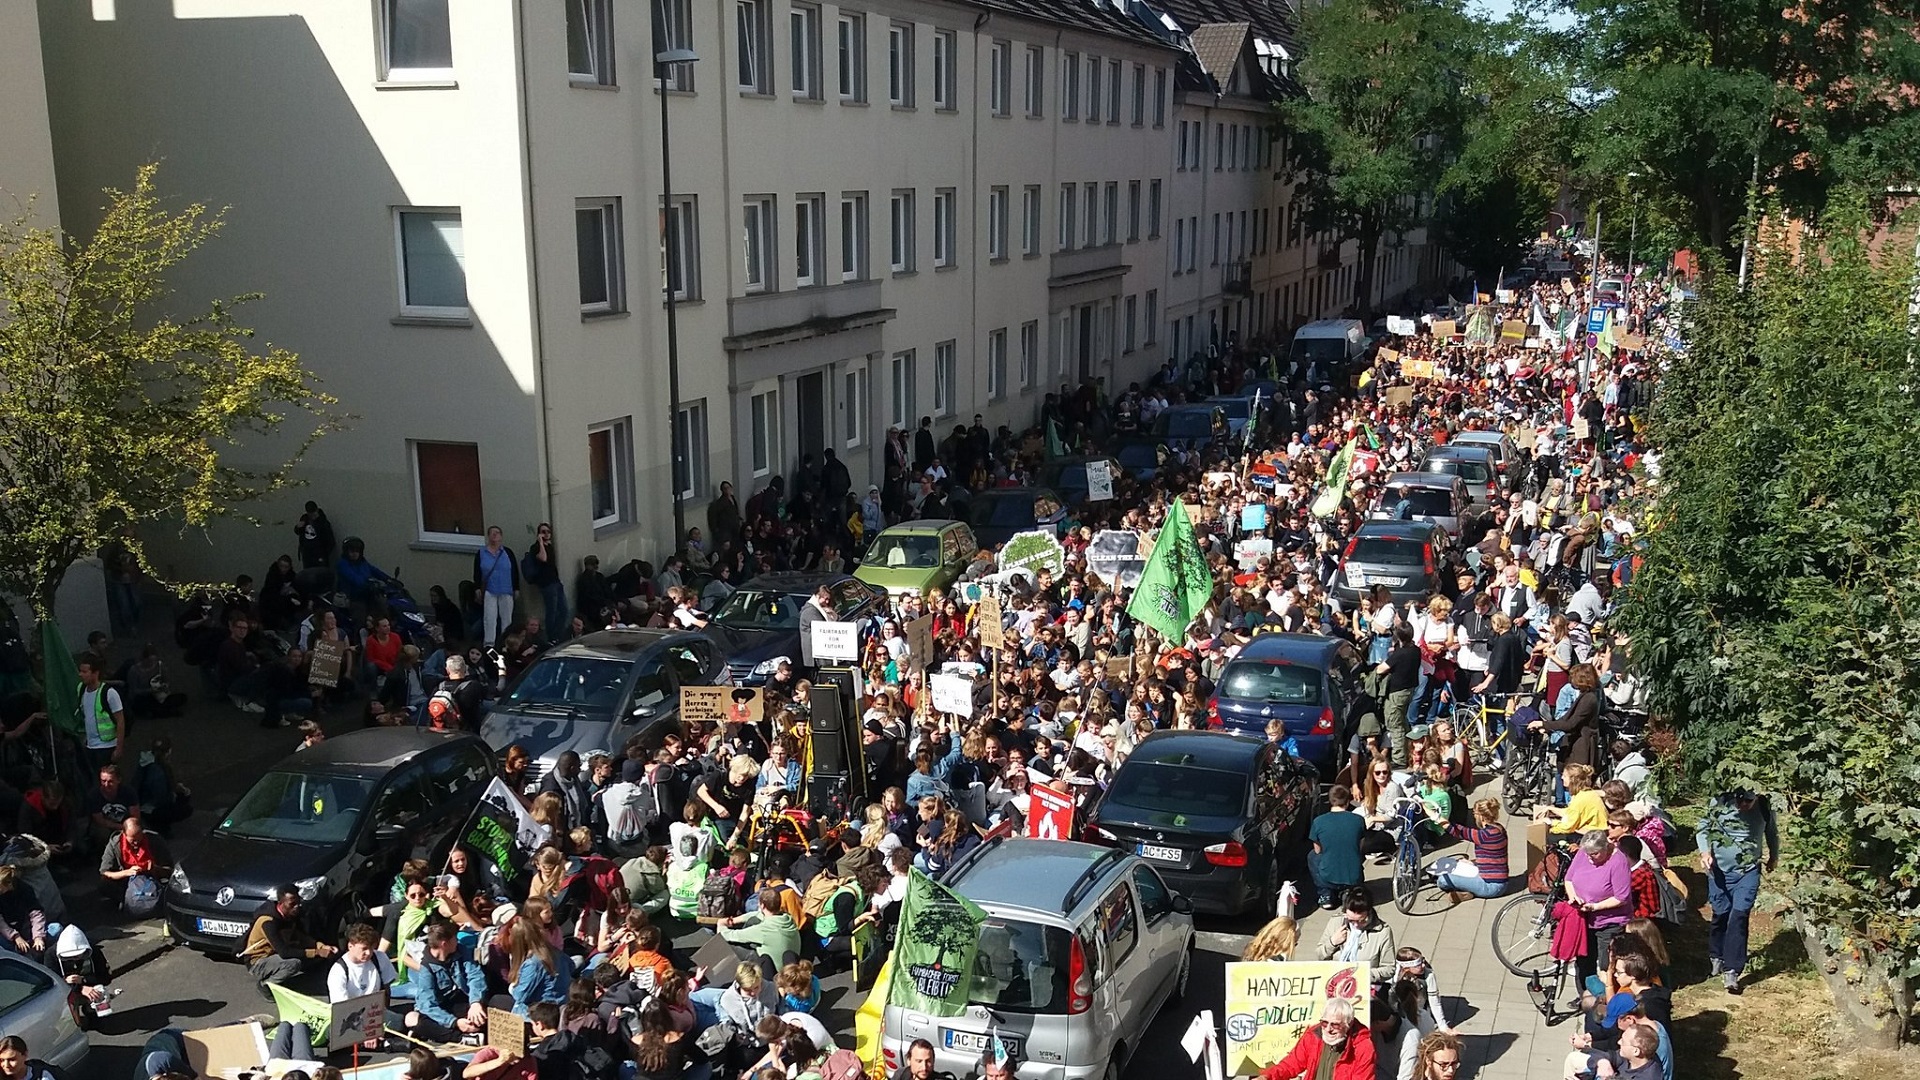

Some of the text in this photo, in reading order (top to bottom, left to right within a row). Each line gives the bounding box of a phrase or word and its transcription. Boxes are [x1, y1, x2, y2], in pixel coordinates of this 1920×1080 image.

[1091, 554, 1117, 562] CLEAN
[1117, 554, 1134, 562] THE
[316, 640, 336, 653] Keine
[684, 690, 696, 698] Die
[684, 699, 708, 707] Herren
[1143, 847, 1181, 860] AC FS5
[675, 888, 695, 897] Orga
[203, 920, 214, 931] AC
[218, 922, 229, 933] NA
[911, 965, 960, 984] HAMBACHER FORST
[917, 978, 950, 997] BLEIBT!
[1247, 976, 1322, 997] HANDELT
[954, 1034, 969, 1047] AC
[977, 1038, 992, 1051] EA
